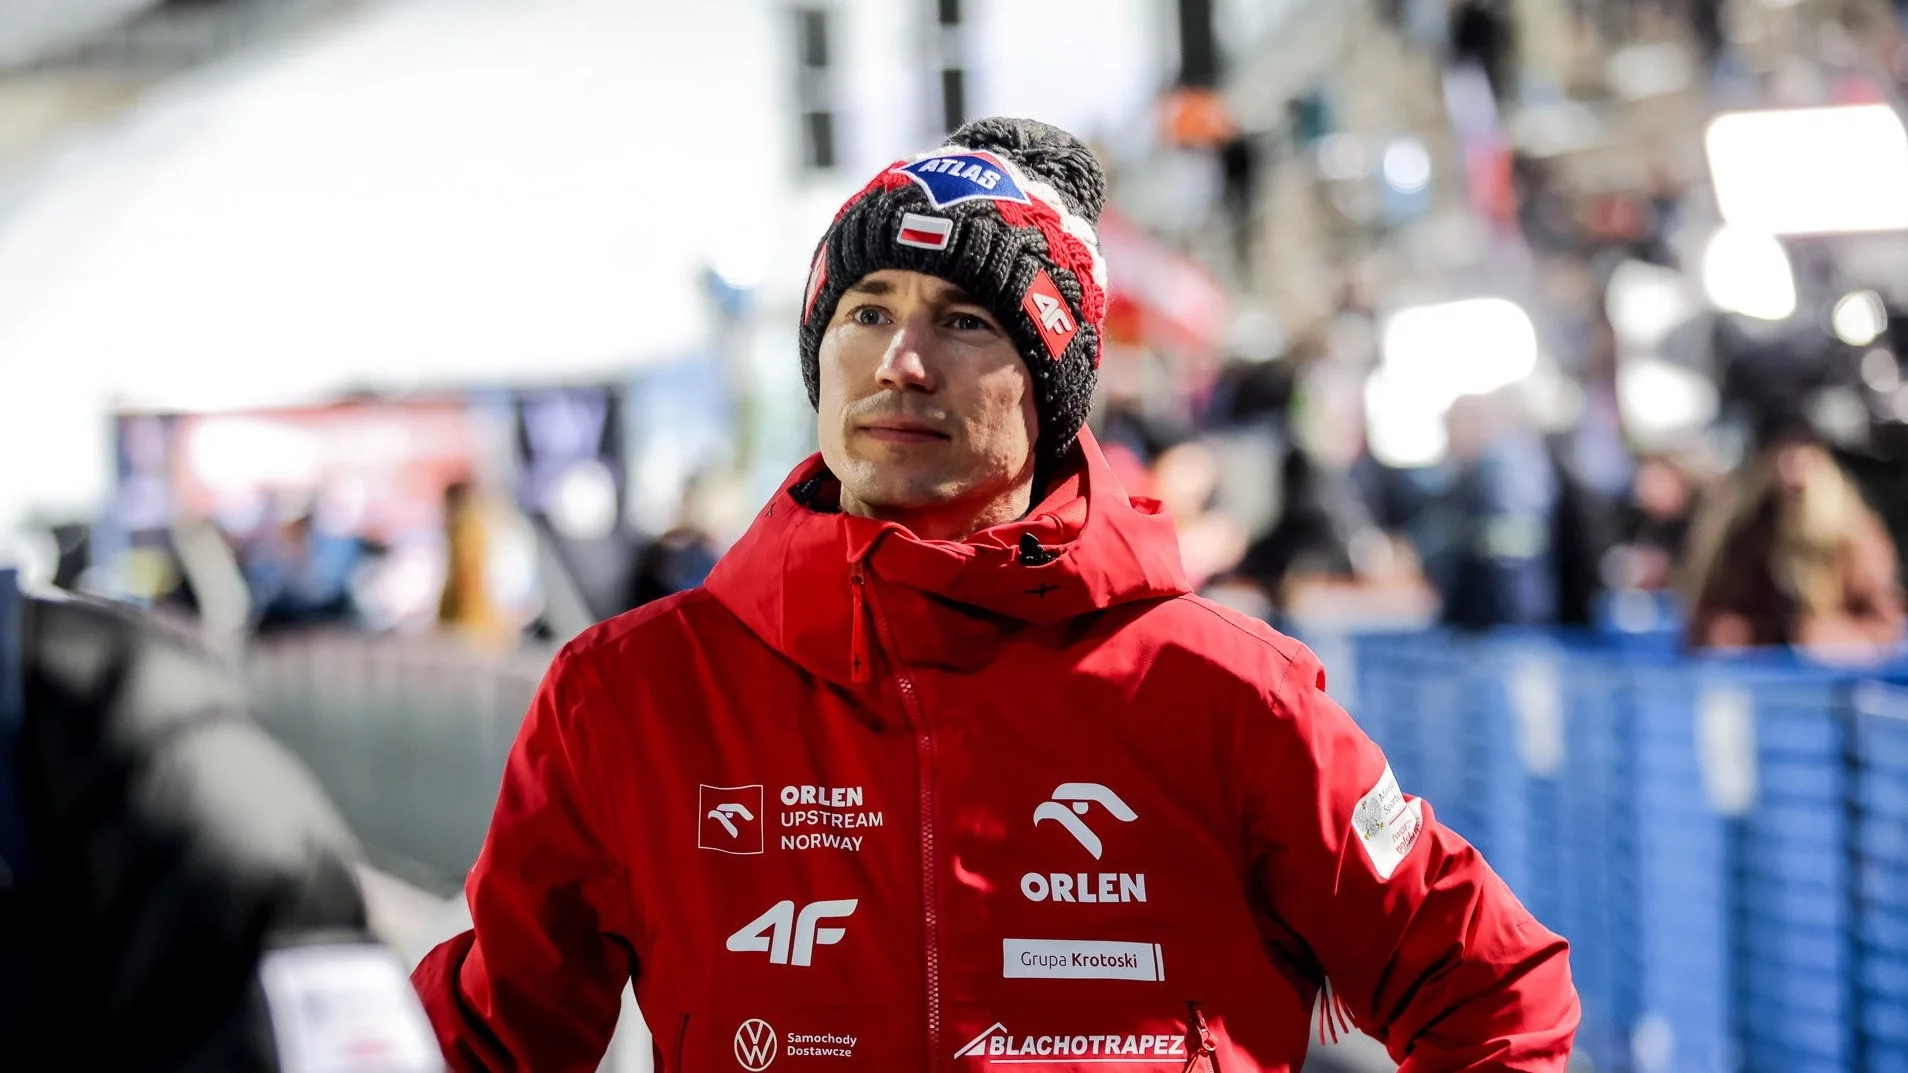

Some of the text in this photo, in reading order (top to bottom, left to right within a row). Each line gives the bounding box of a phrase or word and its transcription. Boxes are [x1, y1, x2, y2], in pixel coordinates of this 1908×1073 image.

[918, 158, 1001, 190] ATLAS
[1032, 292, 1073, 335] 4F
[780, 785, 863, 807] ORLEN
[781, 810, 884, 829] UPSTREAM
[781, 833, 863, 852] NORWAY
[1020, 872, 1147, 903] ORLEN
[726, 899, 858, 967] 4F
[1021, 951, 1138, 969] Grupa Krotoski
[787, 1033, 857, 1047] Samochody
[989, 1035, 1185, 1056] BLACHOTRAPEZ
[787, 1046, 852, 1057] Dostawcze
